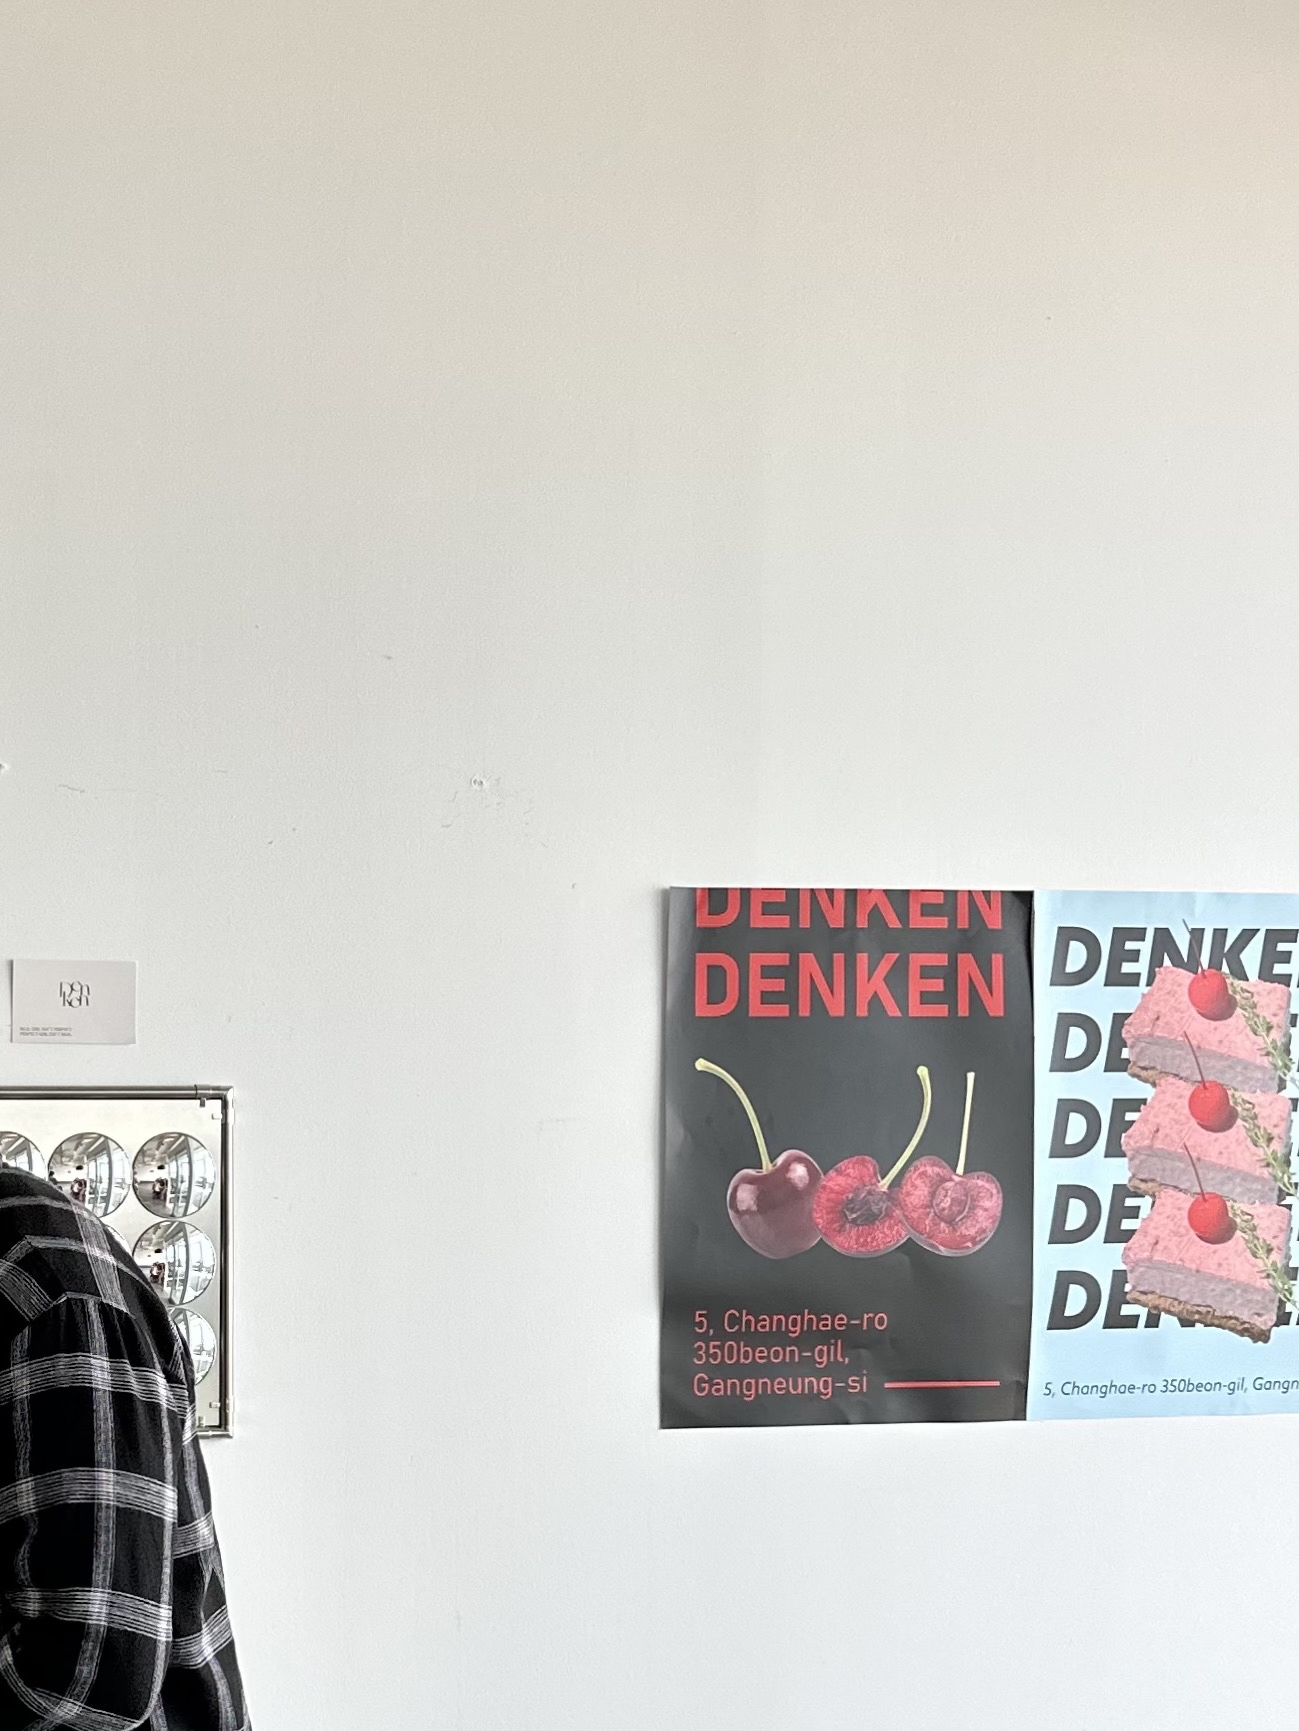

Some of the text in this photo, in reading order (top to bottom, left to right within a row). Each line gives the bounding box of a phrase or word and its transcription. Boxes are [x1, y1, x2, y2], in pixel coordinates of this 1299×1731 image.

[1049, 926, 1299, 987] DENKE
[695, 953, 1005, 1017] DENKEN
[693, 1308, 888, 1338] 5, Changhae-ro
[693, 1338, 850, 1368] 350beon-gil,
[693, 1370, 868, 1401] Gangneung-si
[1043, 1381, 1056, 1398] 5,
[1060, 1379, 1157, 1399] Changhae-ro
[1160, 1376, 1248, 1396] 350beon-gil,
